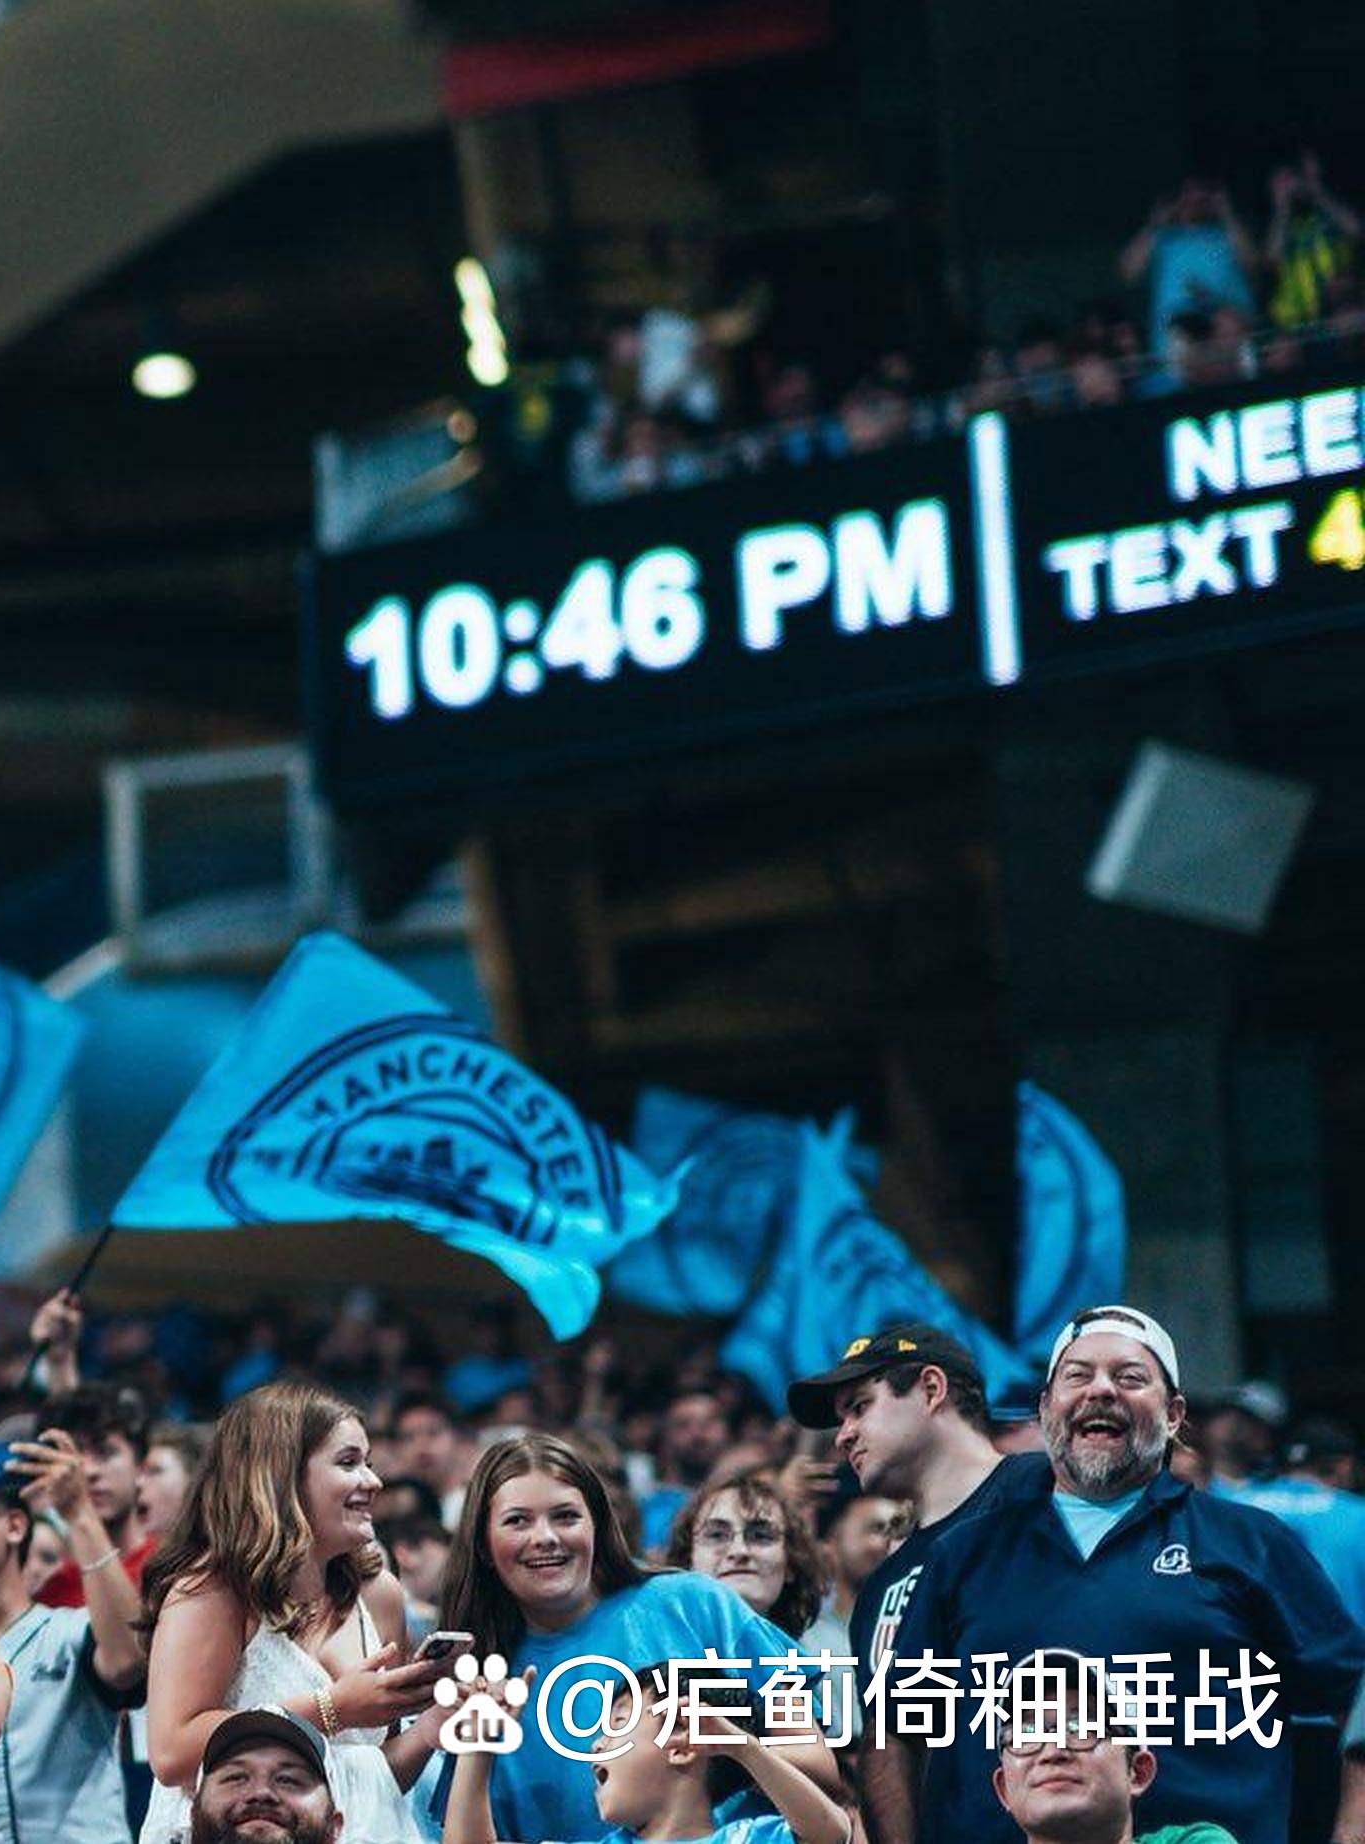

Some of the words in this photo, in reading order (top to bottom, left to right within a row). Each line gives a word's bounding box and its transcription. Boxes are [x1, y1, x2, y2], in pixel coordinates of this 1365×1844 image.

[1166, 385, 1365, 502] NEE
[346, 545, 705, 720] 10:46
[735, 497, 954, 652] PM
[1044, 501, 1296, 622] TEXT
